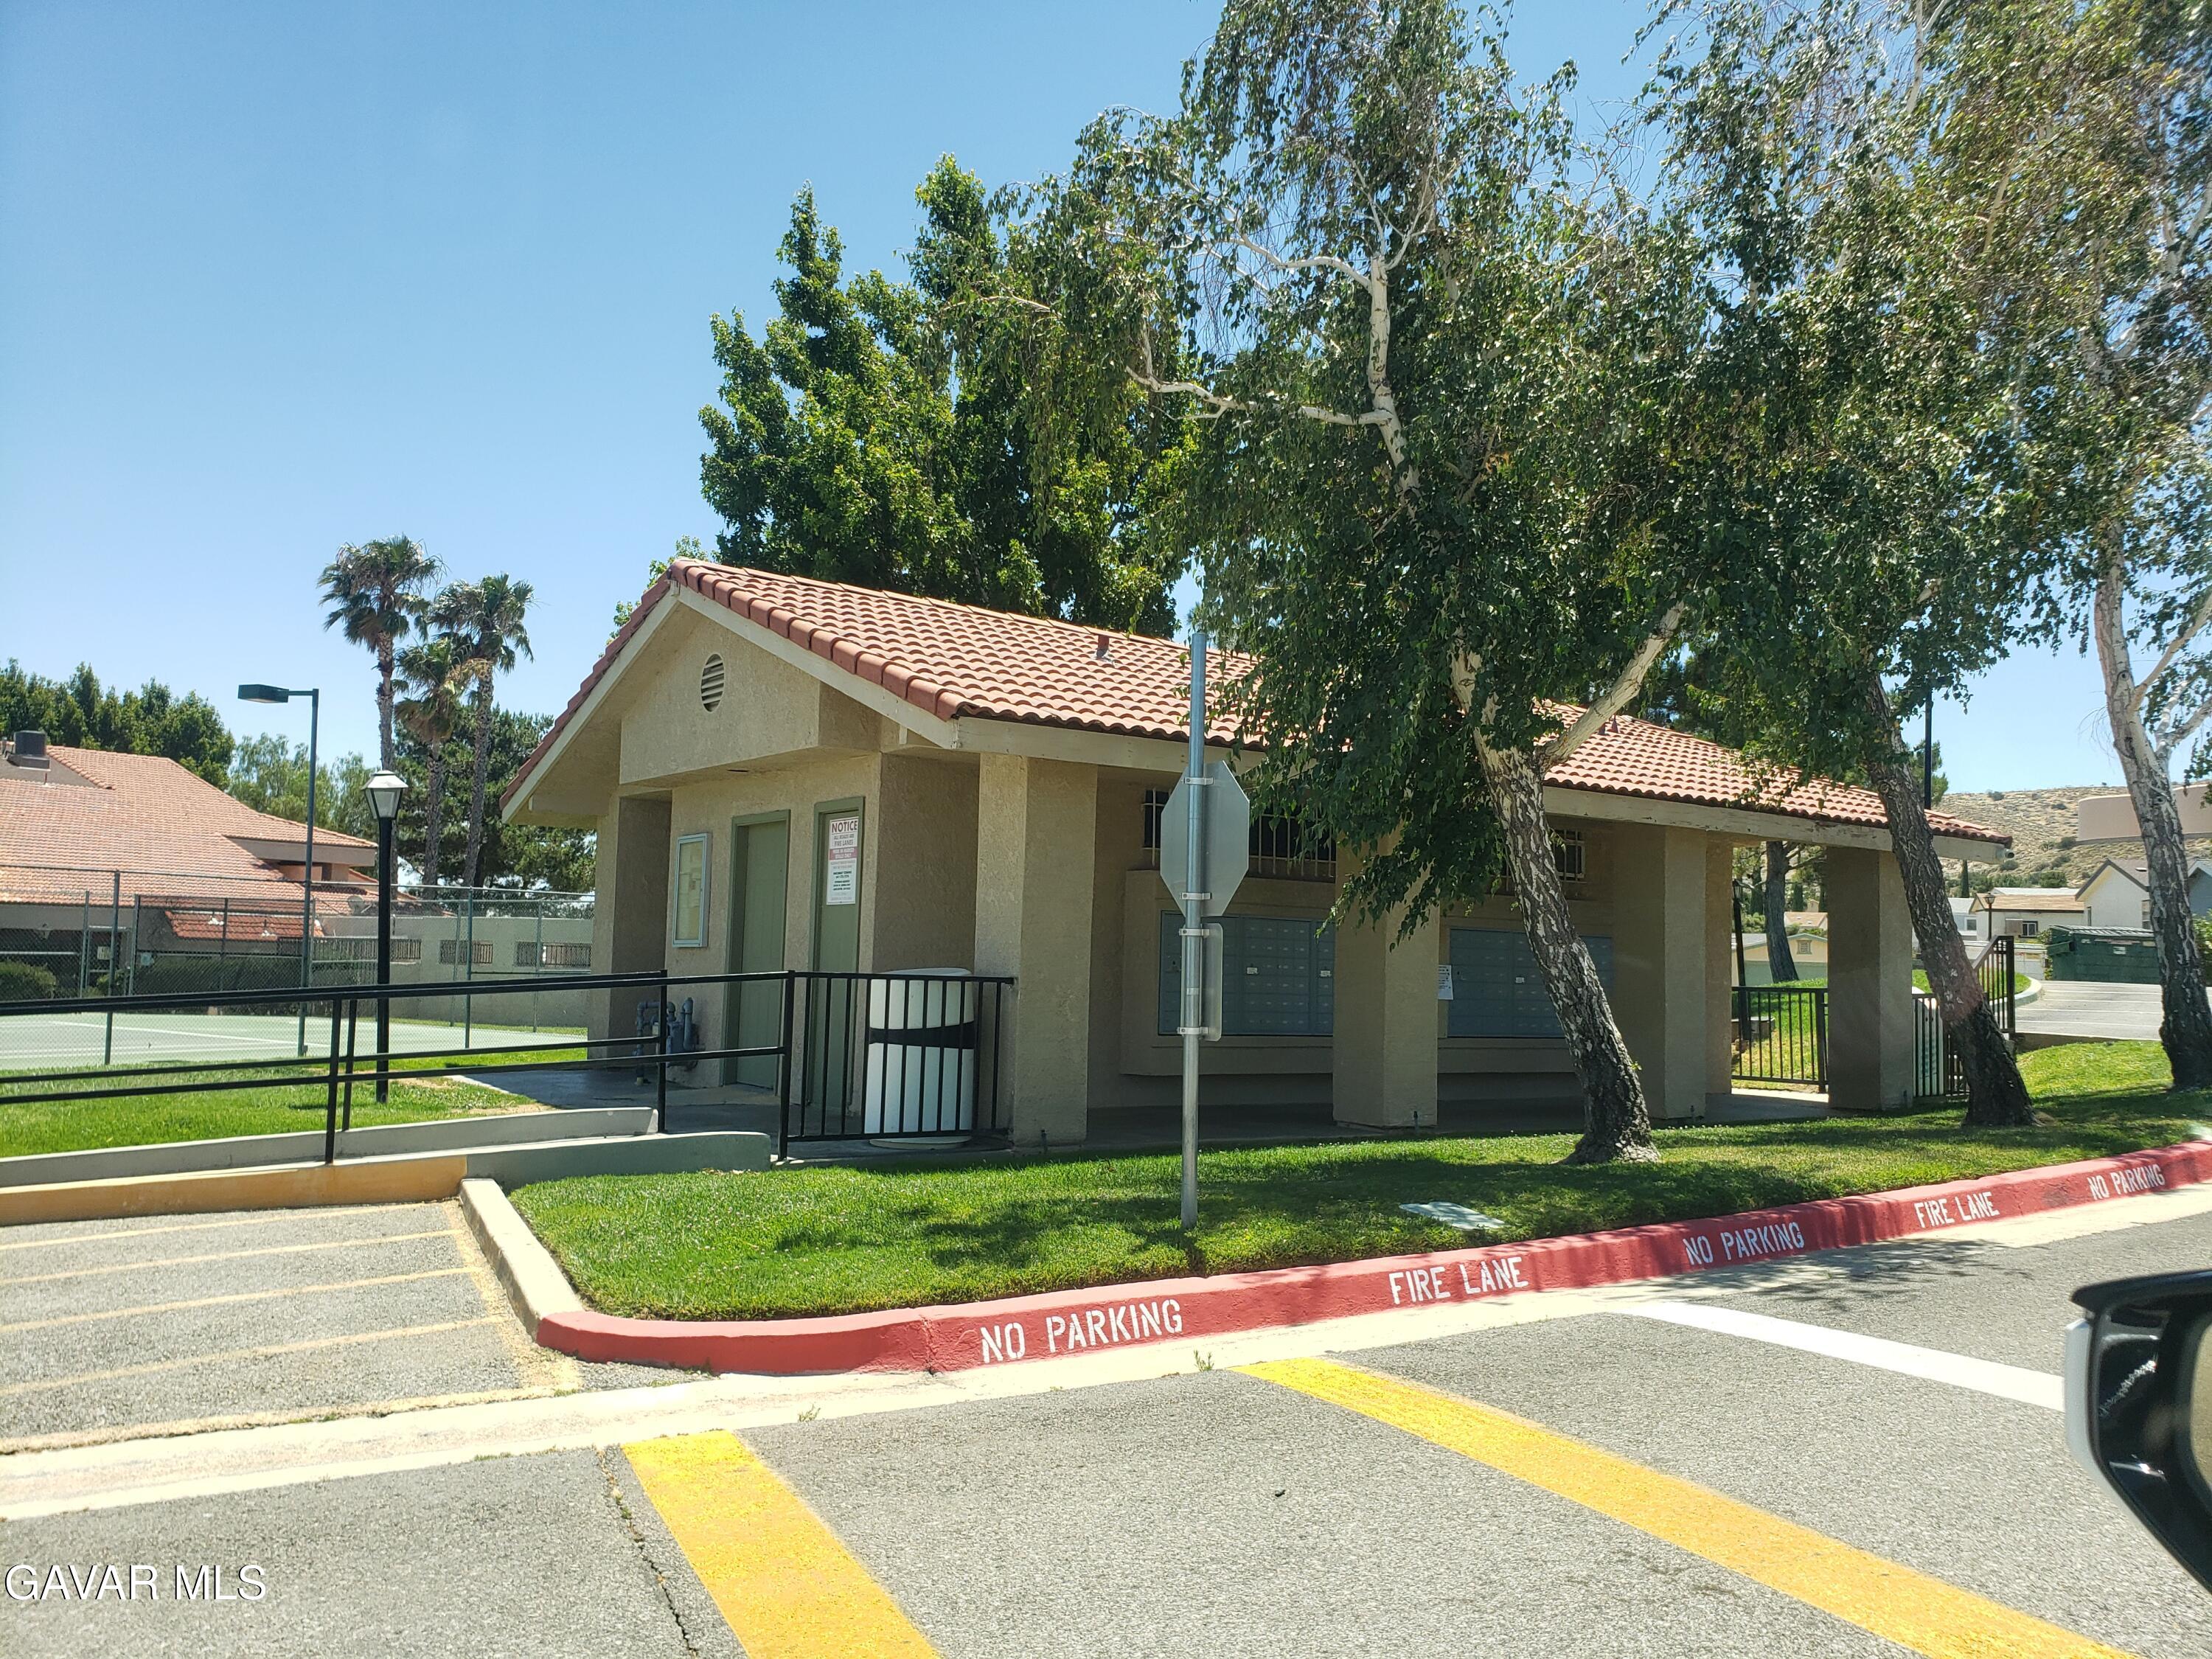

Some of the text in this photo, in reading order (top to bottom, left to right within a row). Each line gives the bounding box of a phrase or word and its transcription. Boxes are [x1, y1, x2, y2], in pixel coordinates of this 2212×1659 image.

[832, 821, 858, 832] NOTICE
[2087, 1164, 2166, 1200] NO PARKING
[1913, 1192, 2000, 1228] FIRE LANE
[1683, 1222, 1805, 1265] NO PARKING
[1388, 1256, 1529, 1305] FIRE LANE
[980, 1299, 1183, 1363] NO PARKING
